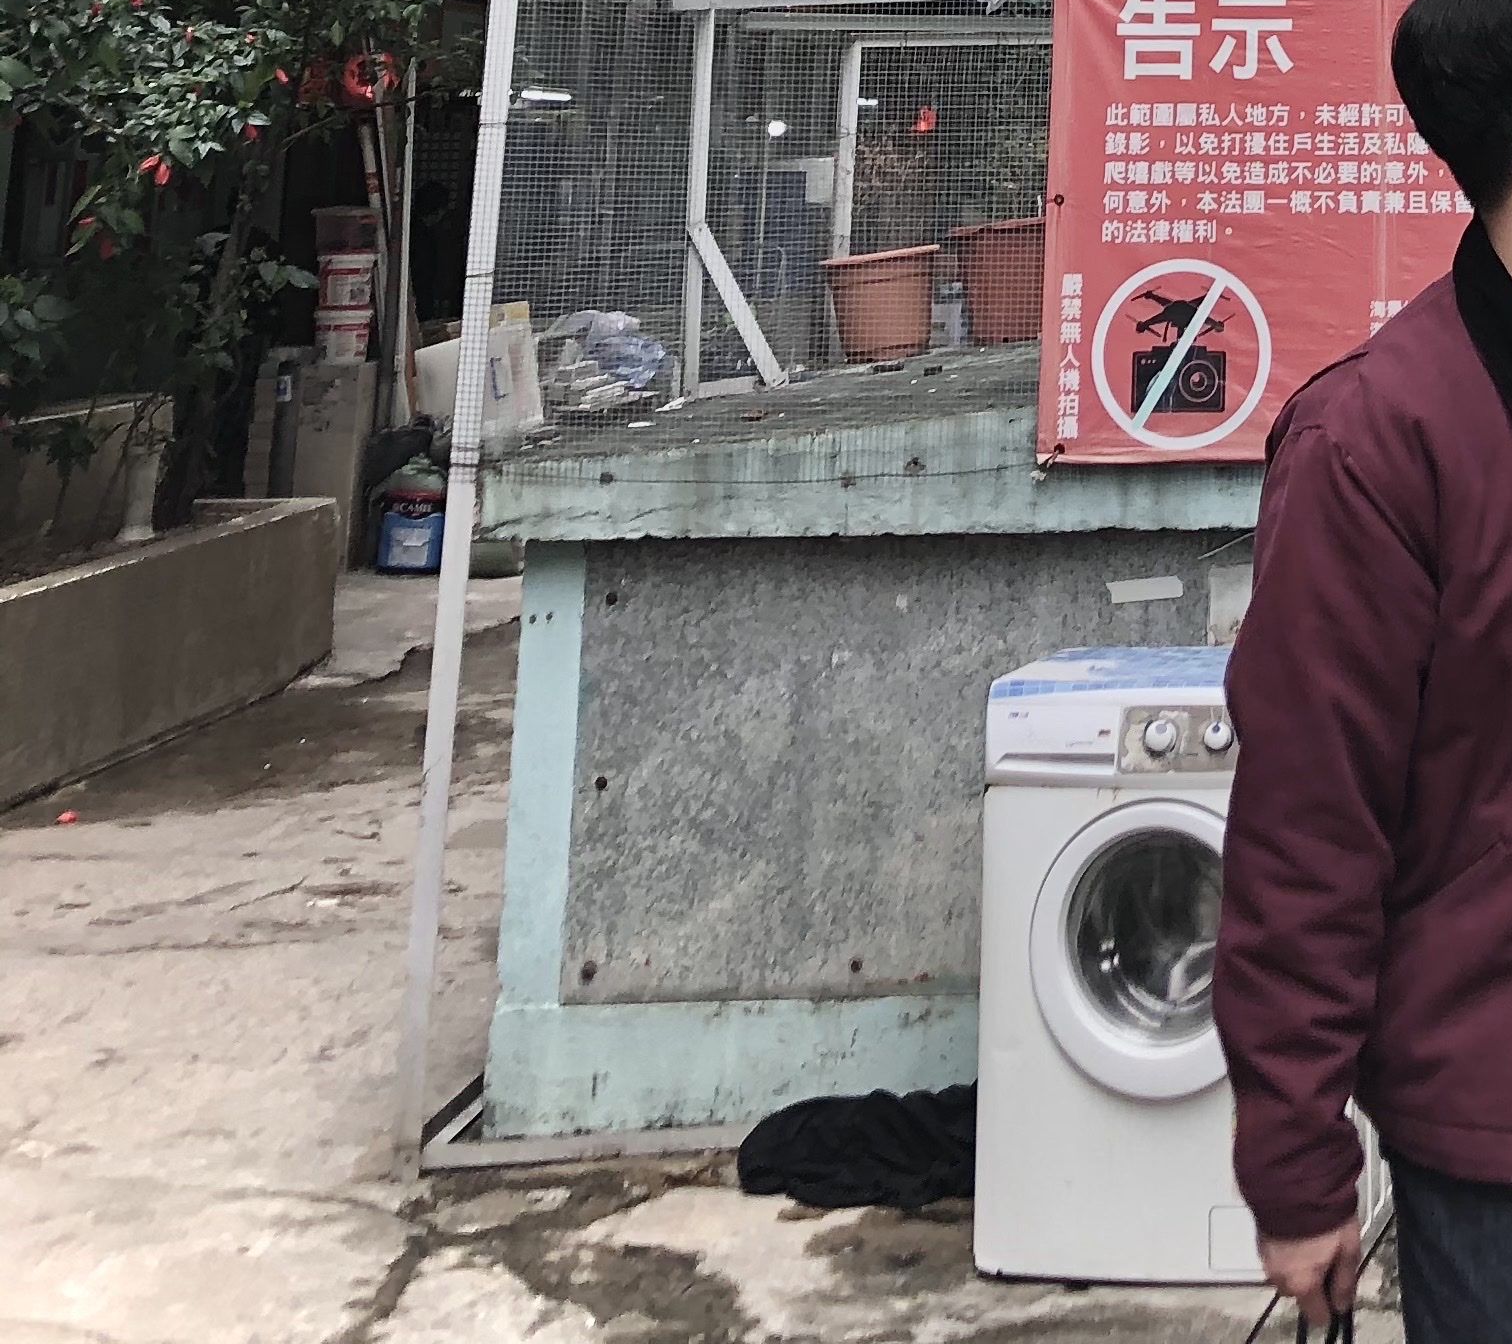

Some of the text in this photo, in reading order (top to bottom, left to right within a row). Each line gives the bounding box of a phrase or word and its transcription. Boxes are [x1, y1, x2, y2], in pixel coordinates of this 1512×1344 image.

[1105, 103, 1412, 126] 此範圍屬私人地方，未經許可
